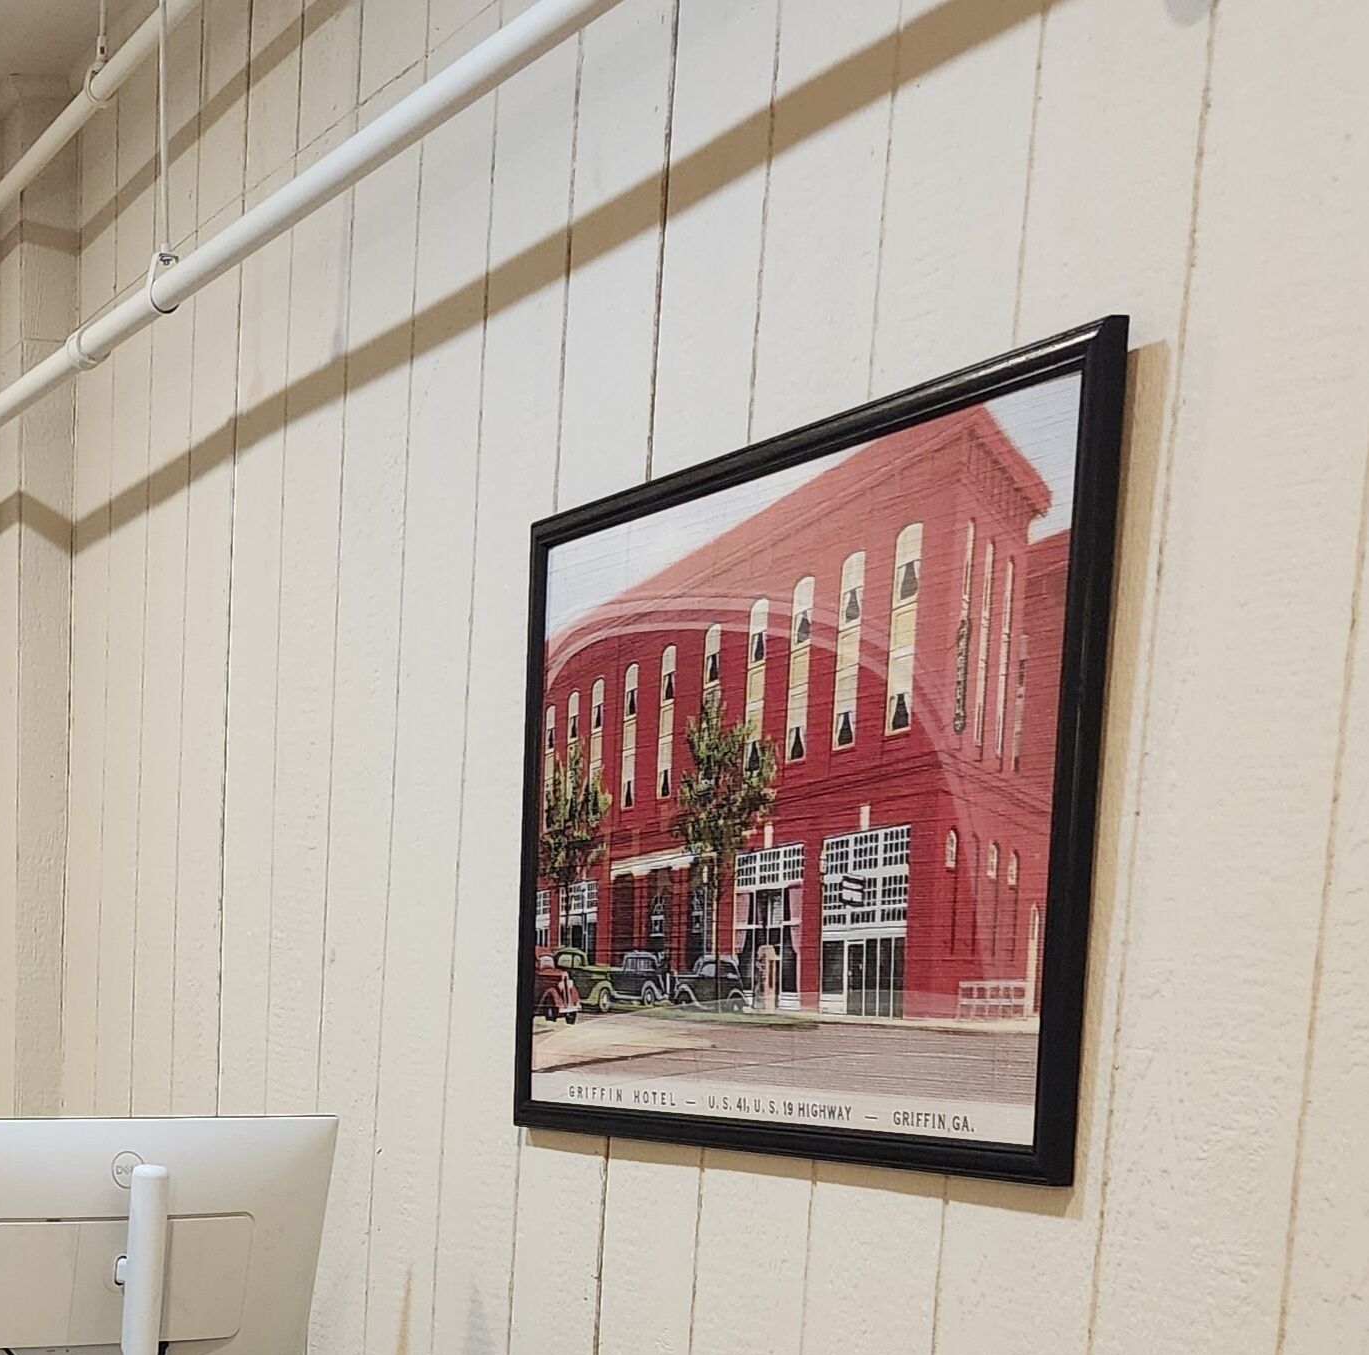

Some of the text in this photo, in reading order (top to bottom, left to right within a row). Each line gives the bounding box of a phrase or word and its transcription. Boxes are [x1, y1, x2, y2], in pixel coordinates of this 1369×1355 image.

[568, 1085, 623, 1102] GRIFFIN
[633, 1090, 676, 1106] HOTEL
[782, 1100, 794, 1116] 19
[797, 1102, 852, 1121] HIGHWAY
